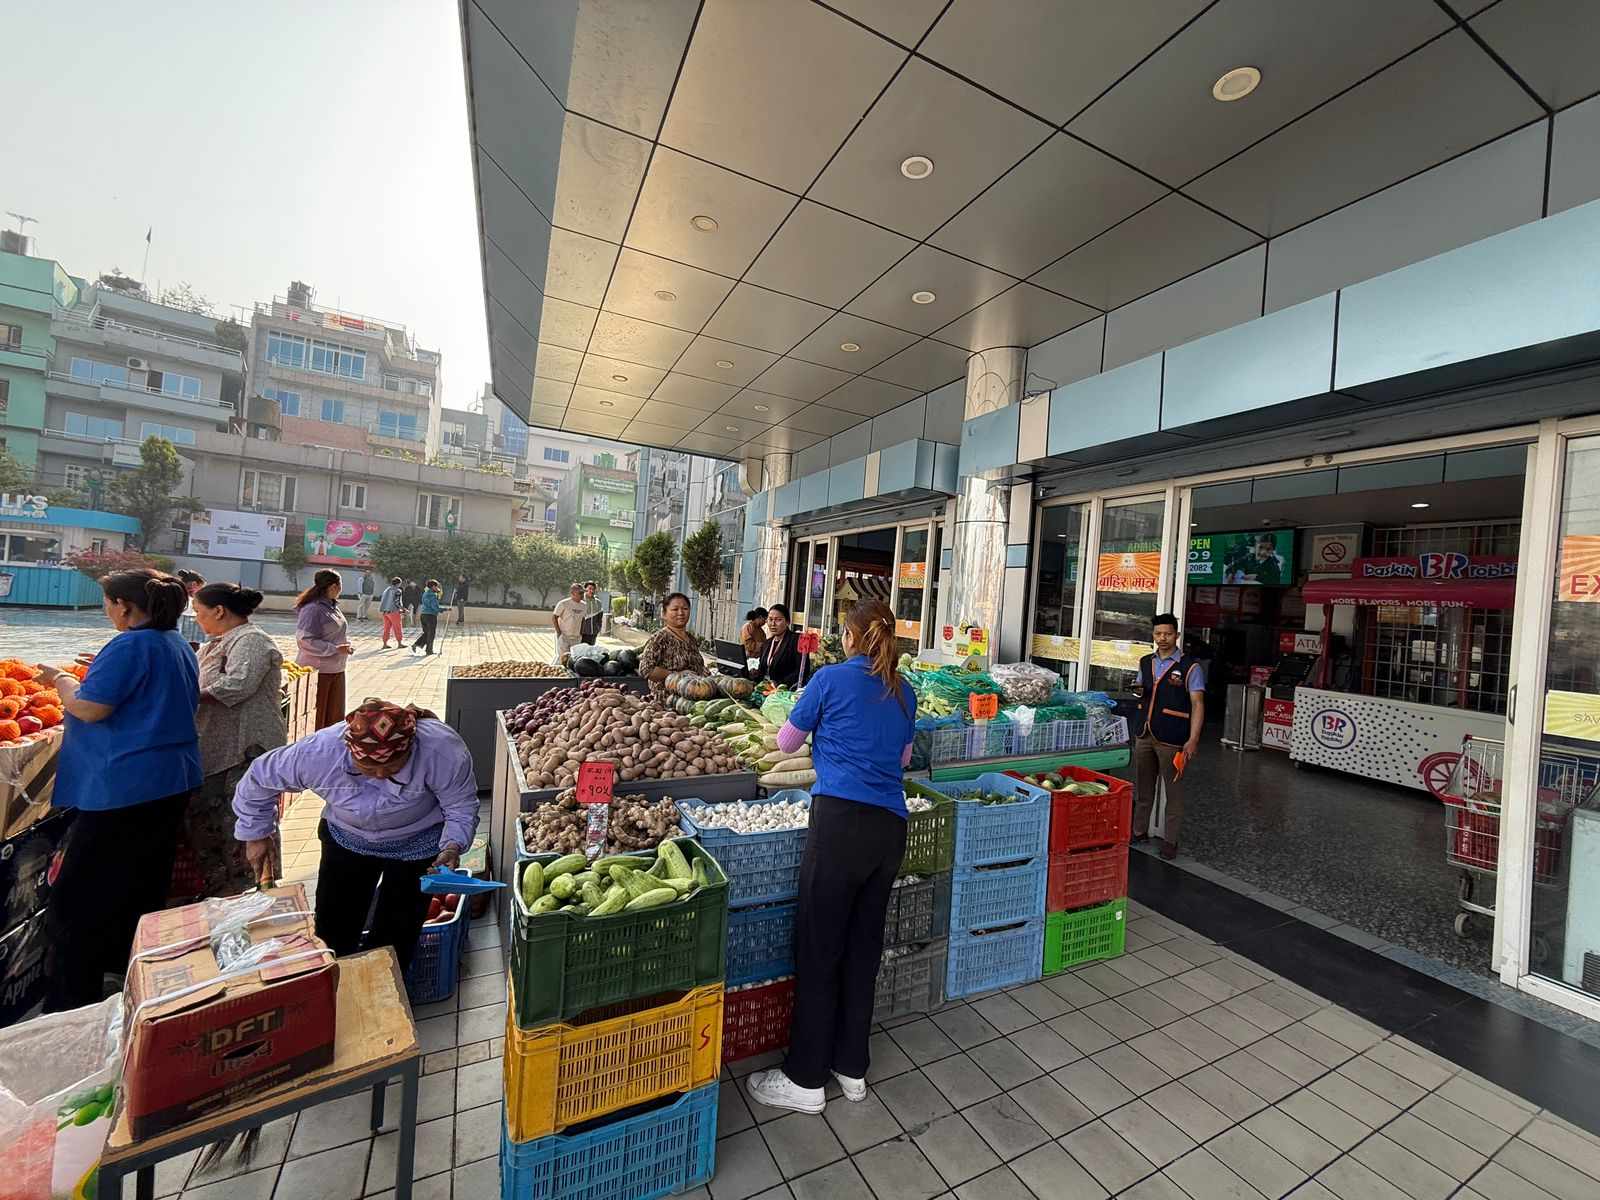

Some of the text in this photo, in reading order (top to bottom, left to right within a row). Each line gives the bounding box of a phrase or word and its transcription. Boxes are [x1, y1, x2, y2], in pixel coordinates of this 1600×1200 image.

[1363, 562, 1417, 578] baskin
[1420, 552, 1468, 579] BR
[1296, 639, 1322, 650] ATM
[1321, 715, 1347, 733] BR
[211, 1009, 276, 1050] DFT
